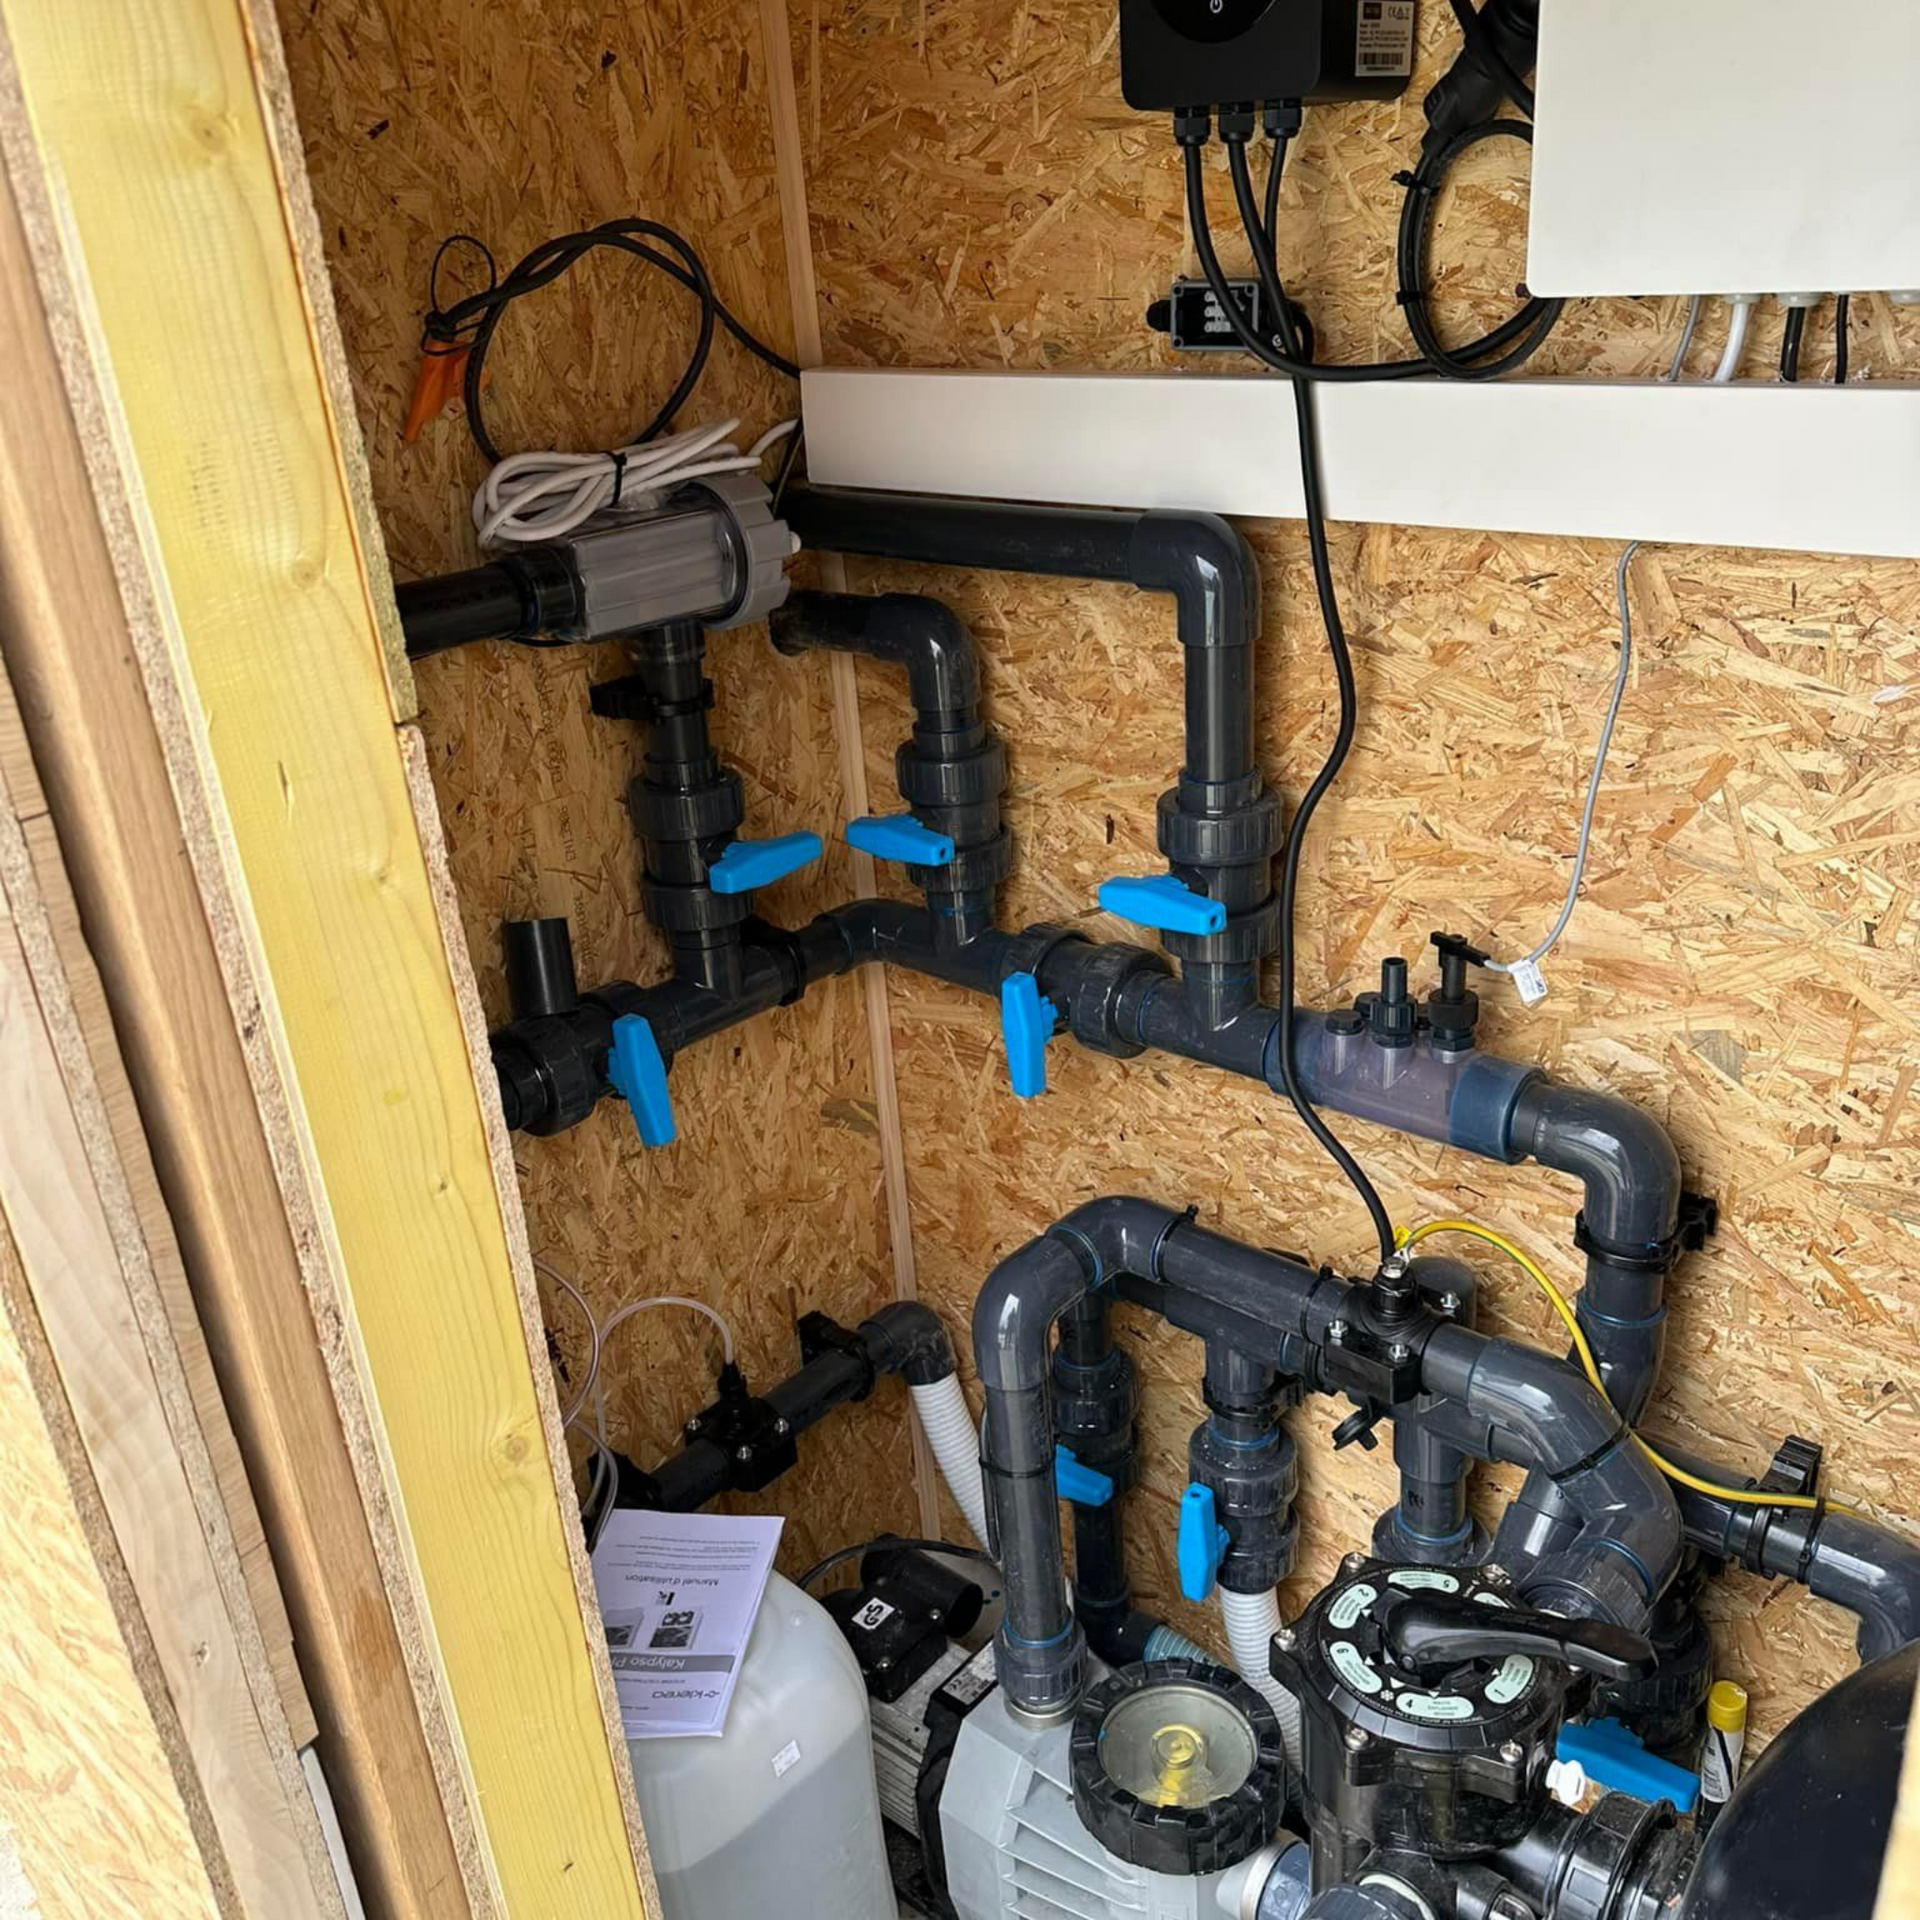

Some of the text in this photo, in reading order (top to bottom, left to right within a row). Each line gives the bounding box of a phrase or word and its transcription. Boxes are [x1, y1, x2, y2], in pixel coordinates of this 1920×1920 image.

[682, 1578, 720, 1587] Manuel
[630, 1656, 686, 1671] Kalypso
[651, 1690, 704, 1700] klereo
[1405, 1698, 1414, 1709] 4
